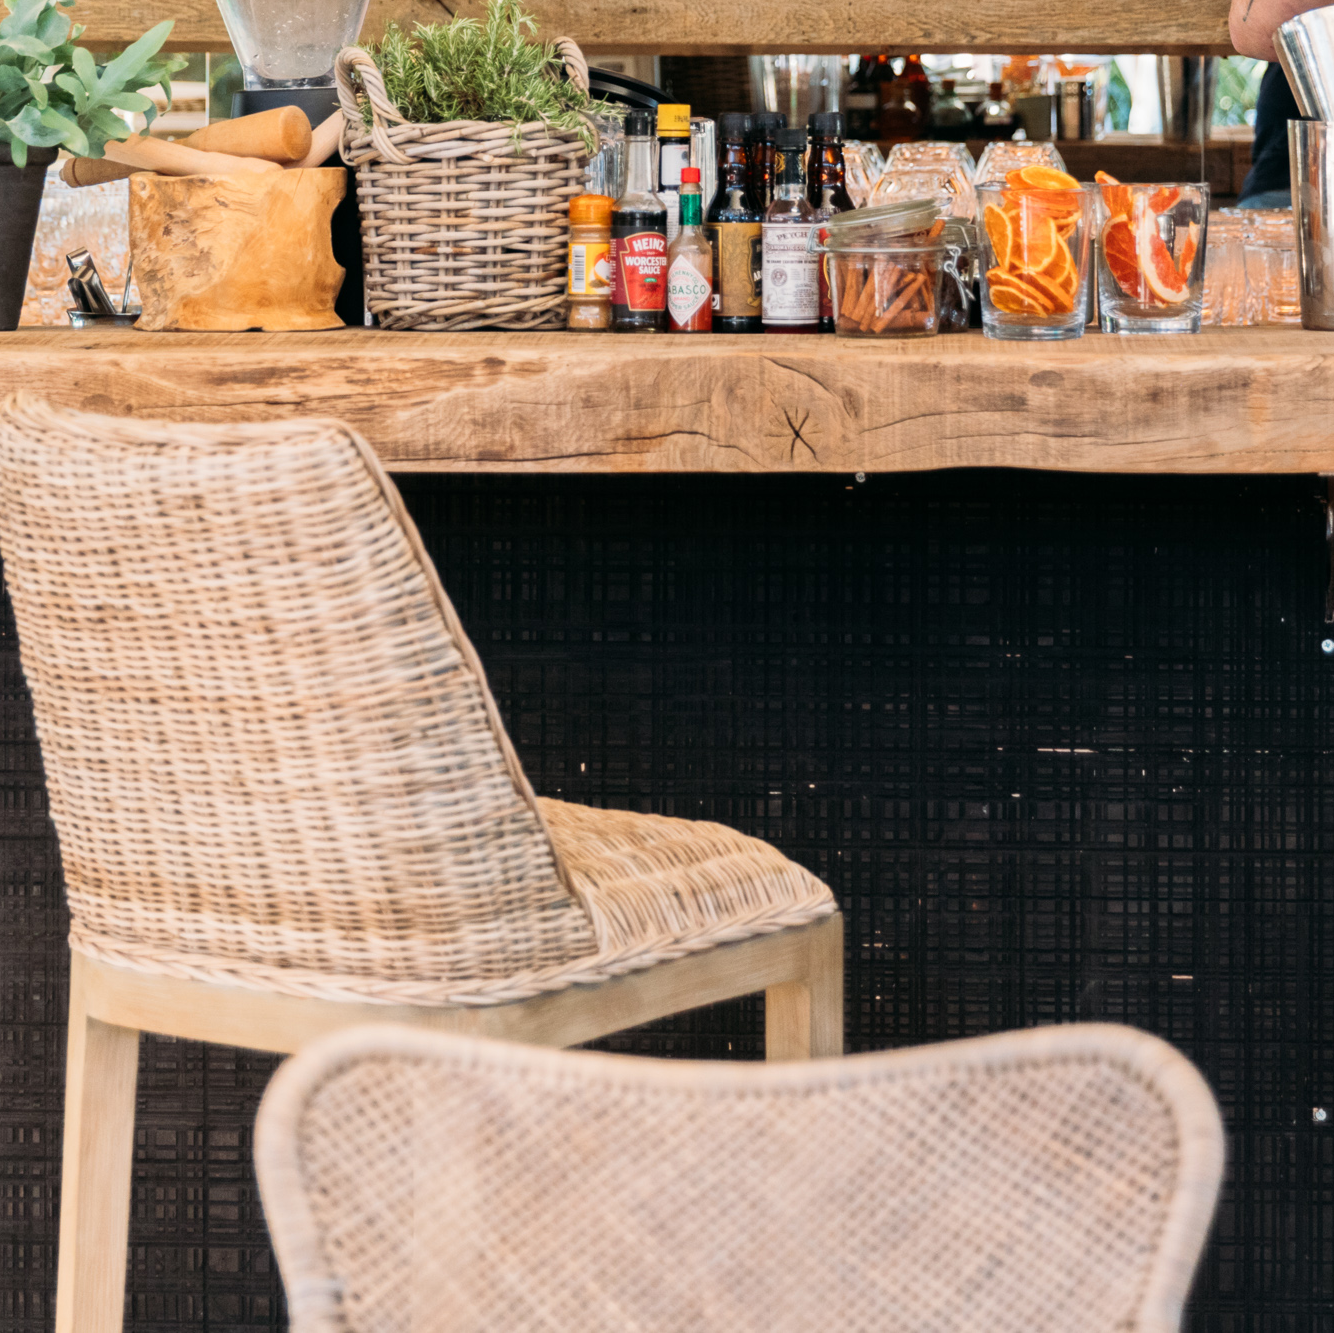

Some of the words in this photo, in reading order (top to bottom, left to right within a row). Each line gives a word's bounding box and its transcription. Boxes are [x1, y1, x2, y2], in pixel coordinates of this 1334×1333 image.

[775, 231, 808, 241] PEYCH
[632, 237, 665, 253] HEINZ
[638, 266, 661, 275] SAUCE
[668, 284, 707, 295] ABASCO
